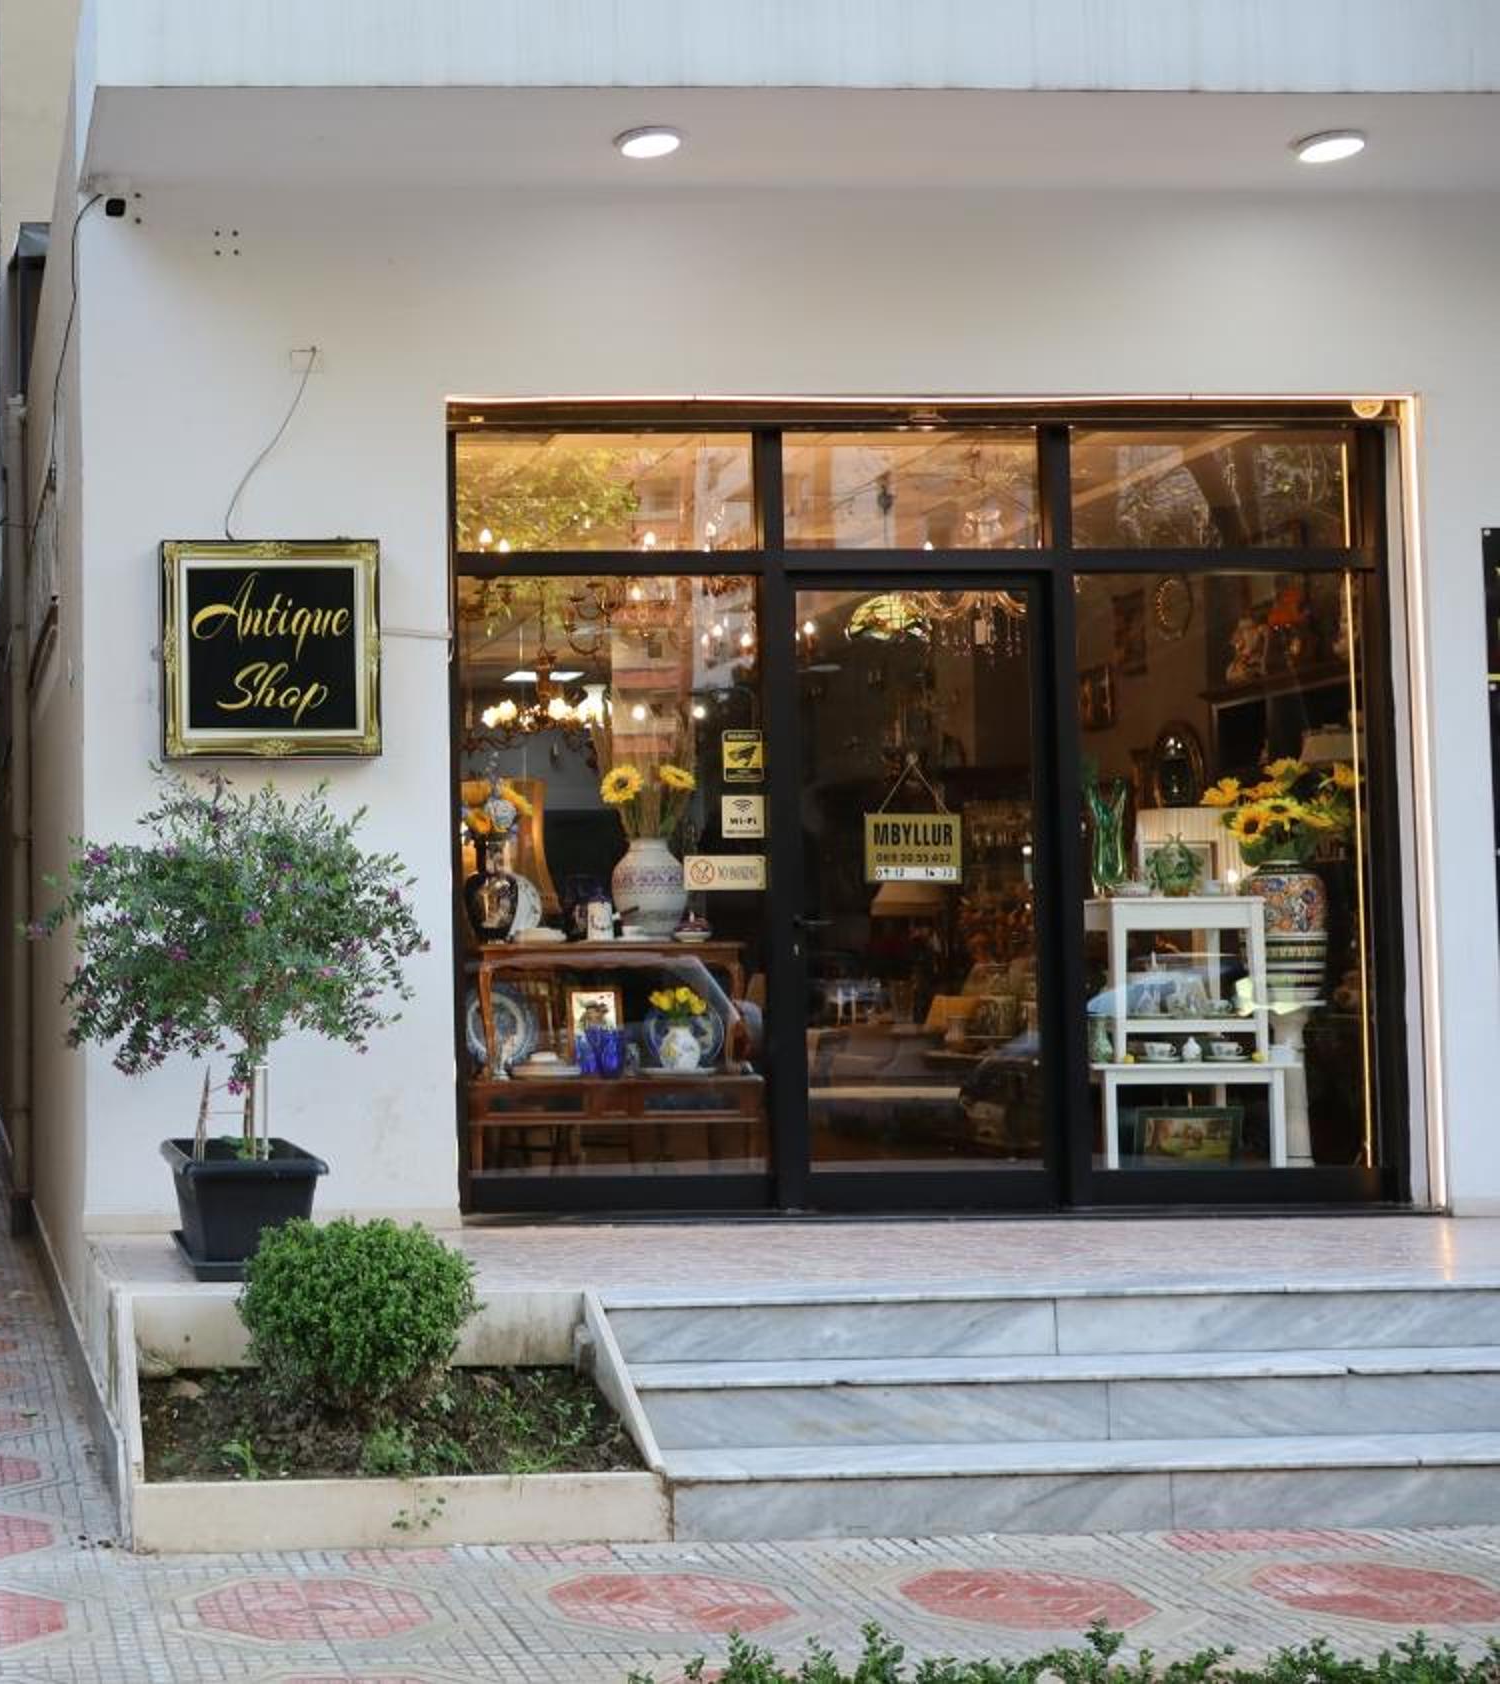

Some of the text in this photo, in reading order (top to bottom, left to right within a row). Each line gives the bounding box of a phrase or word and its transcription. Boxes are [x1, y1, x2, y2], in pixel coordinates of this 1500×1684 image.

[191, 570, 352, 662] Antique
[215, 661, 329, 727] Shop
[873, 821, 953, 847] MBYLLUR
